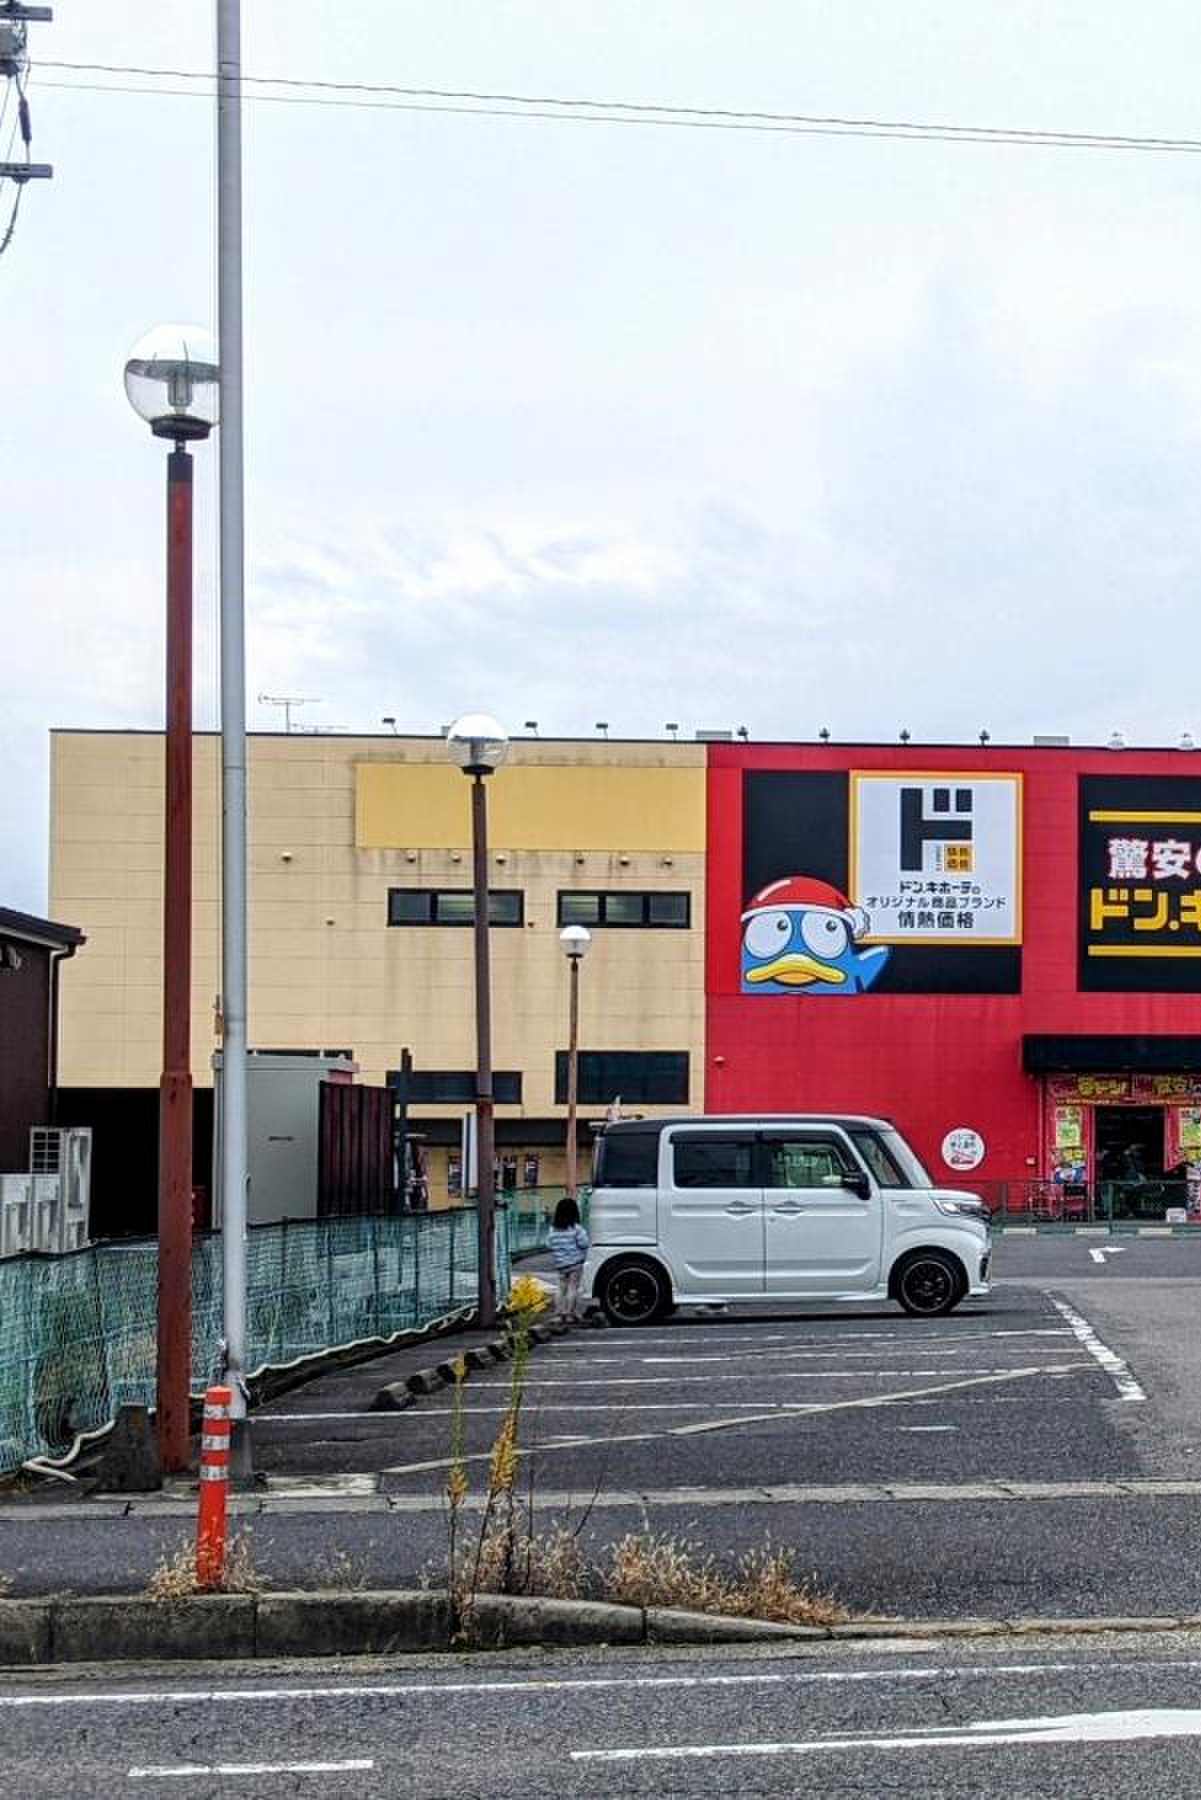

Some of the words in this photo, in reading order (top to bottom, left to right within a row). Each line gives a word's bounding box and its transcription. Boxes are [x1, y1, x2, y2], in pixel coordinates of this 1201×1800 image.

[866, 896, 1006, 909] オリジナル商品ブランド
[899, 911, 974, 929] 情熱価格
